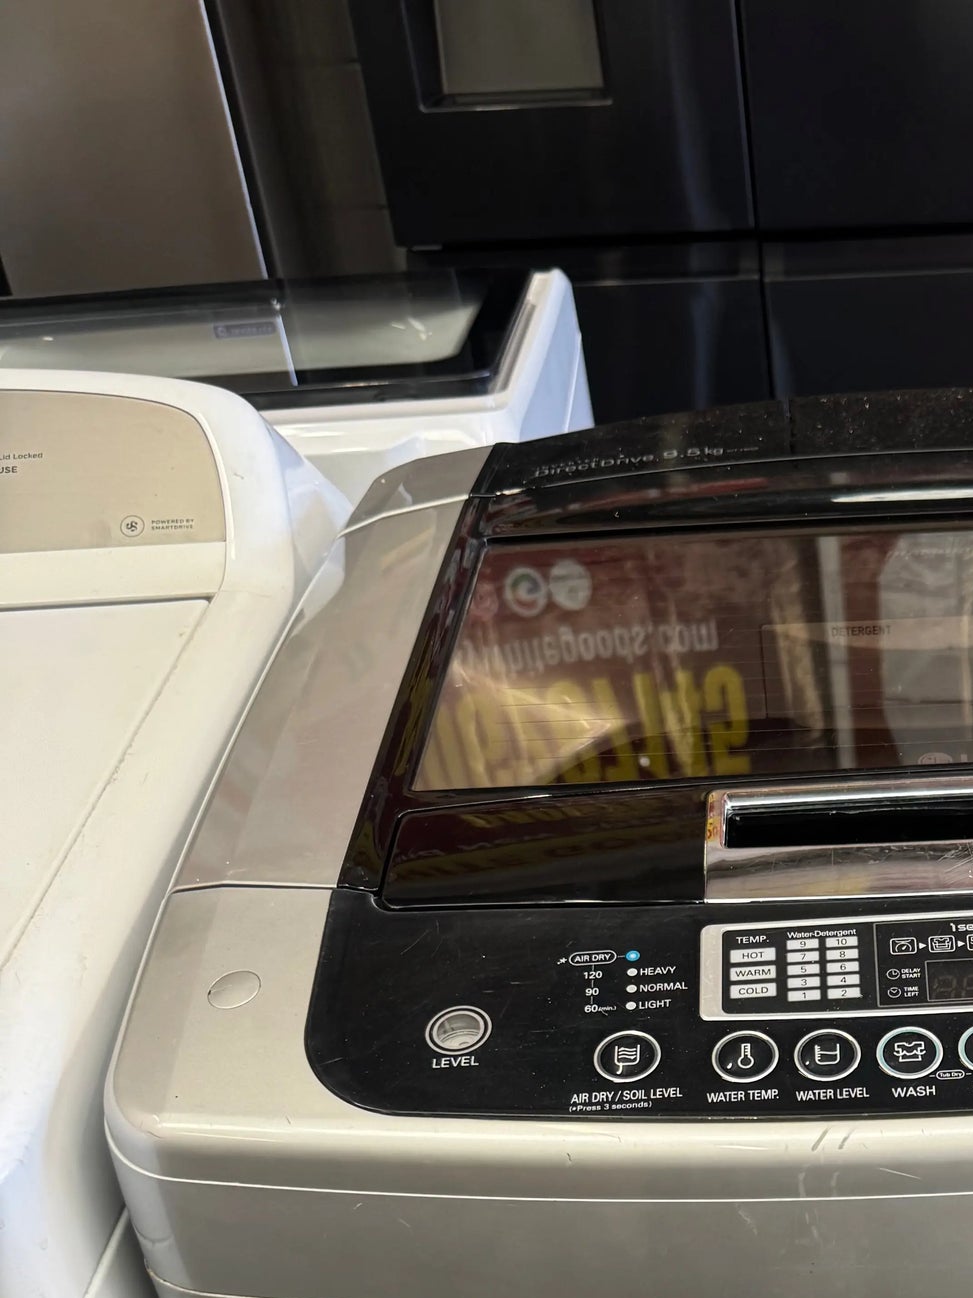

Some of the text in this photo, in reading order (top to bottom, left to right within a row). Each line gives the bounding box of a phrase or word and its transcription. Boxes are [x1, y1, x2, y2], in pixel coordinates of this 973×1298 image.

[12, 452, 43, 460] Locked
[831, 625, 891, 638] DETERGENT
[787, 929, 857, 940] Water-Detergent
[736, 935, 770, 945] TEMP.
[574, 953, 612, 962] AIR DRY
[742, 951, 765, 959] HOT
[583, 971, 603, 979] 120
[640, 966, 676, 976] HEAVY
[735, 969, 772, 978] WARM
[840, 976, 847, 984] 4
[585, 988, 599, 996] 90
[639, 982, 689, 992] NORMAL
[739, 987, 769, 996] COLD
[841, 989, 848, 997] 2
[638, 999, 671, 1009] LIGHT
[432, 1056, 479, 1069] LEVEL
[570, 1093, 589, 1104] AIR
[591, 1091, 615, 1103] DRY
[622, 1089, 648, 1101] SOIL
[650, 1087, 683, 1099] LEVEL
[707, 1089, 780, 1103] WATER TEMP.
[796, 1087, 870, 1102] WATER LEVEL
[892, 1085, 936, 1098] WASH
[611, 1101, 652, 1110] seconds)
